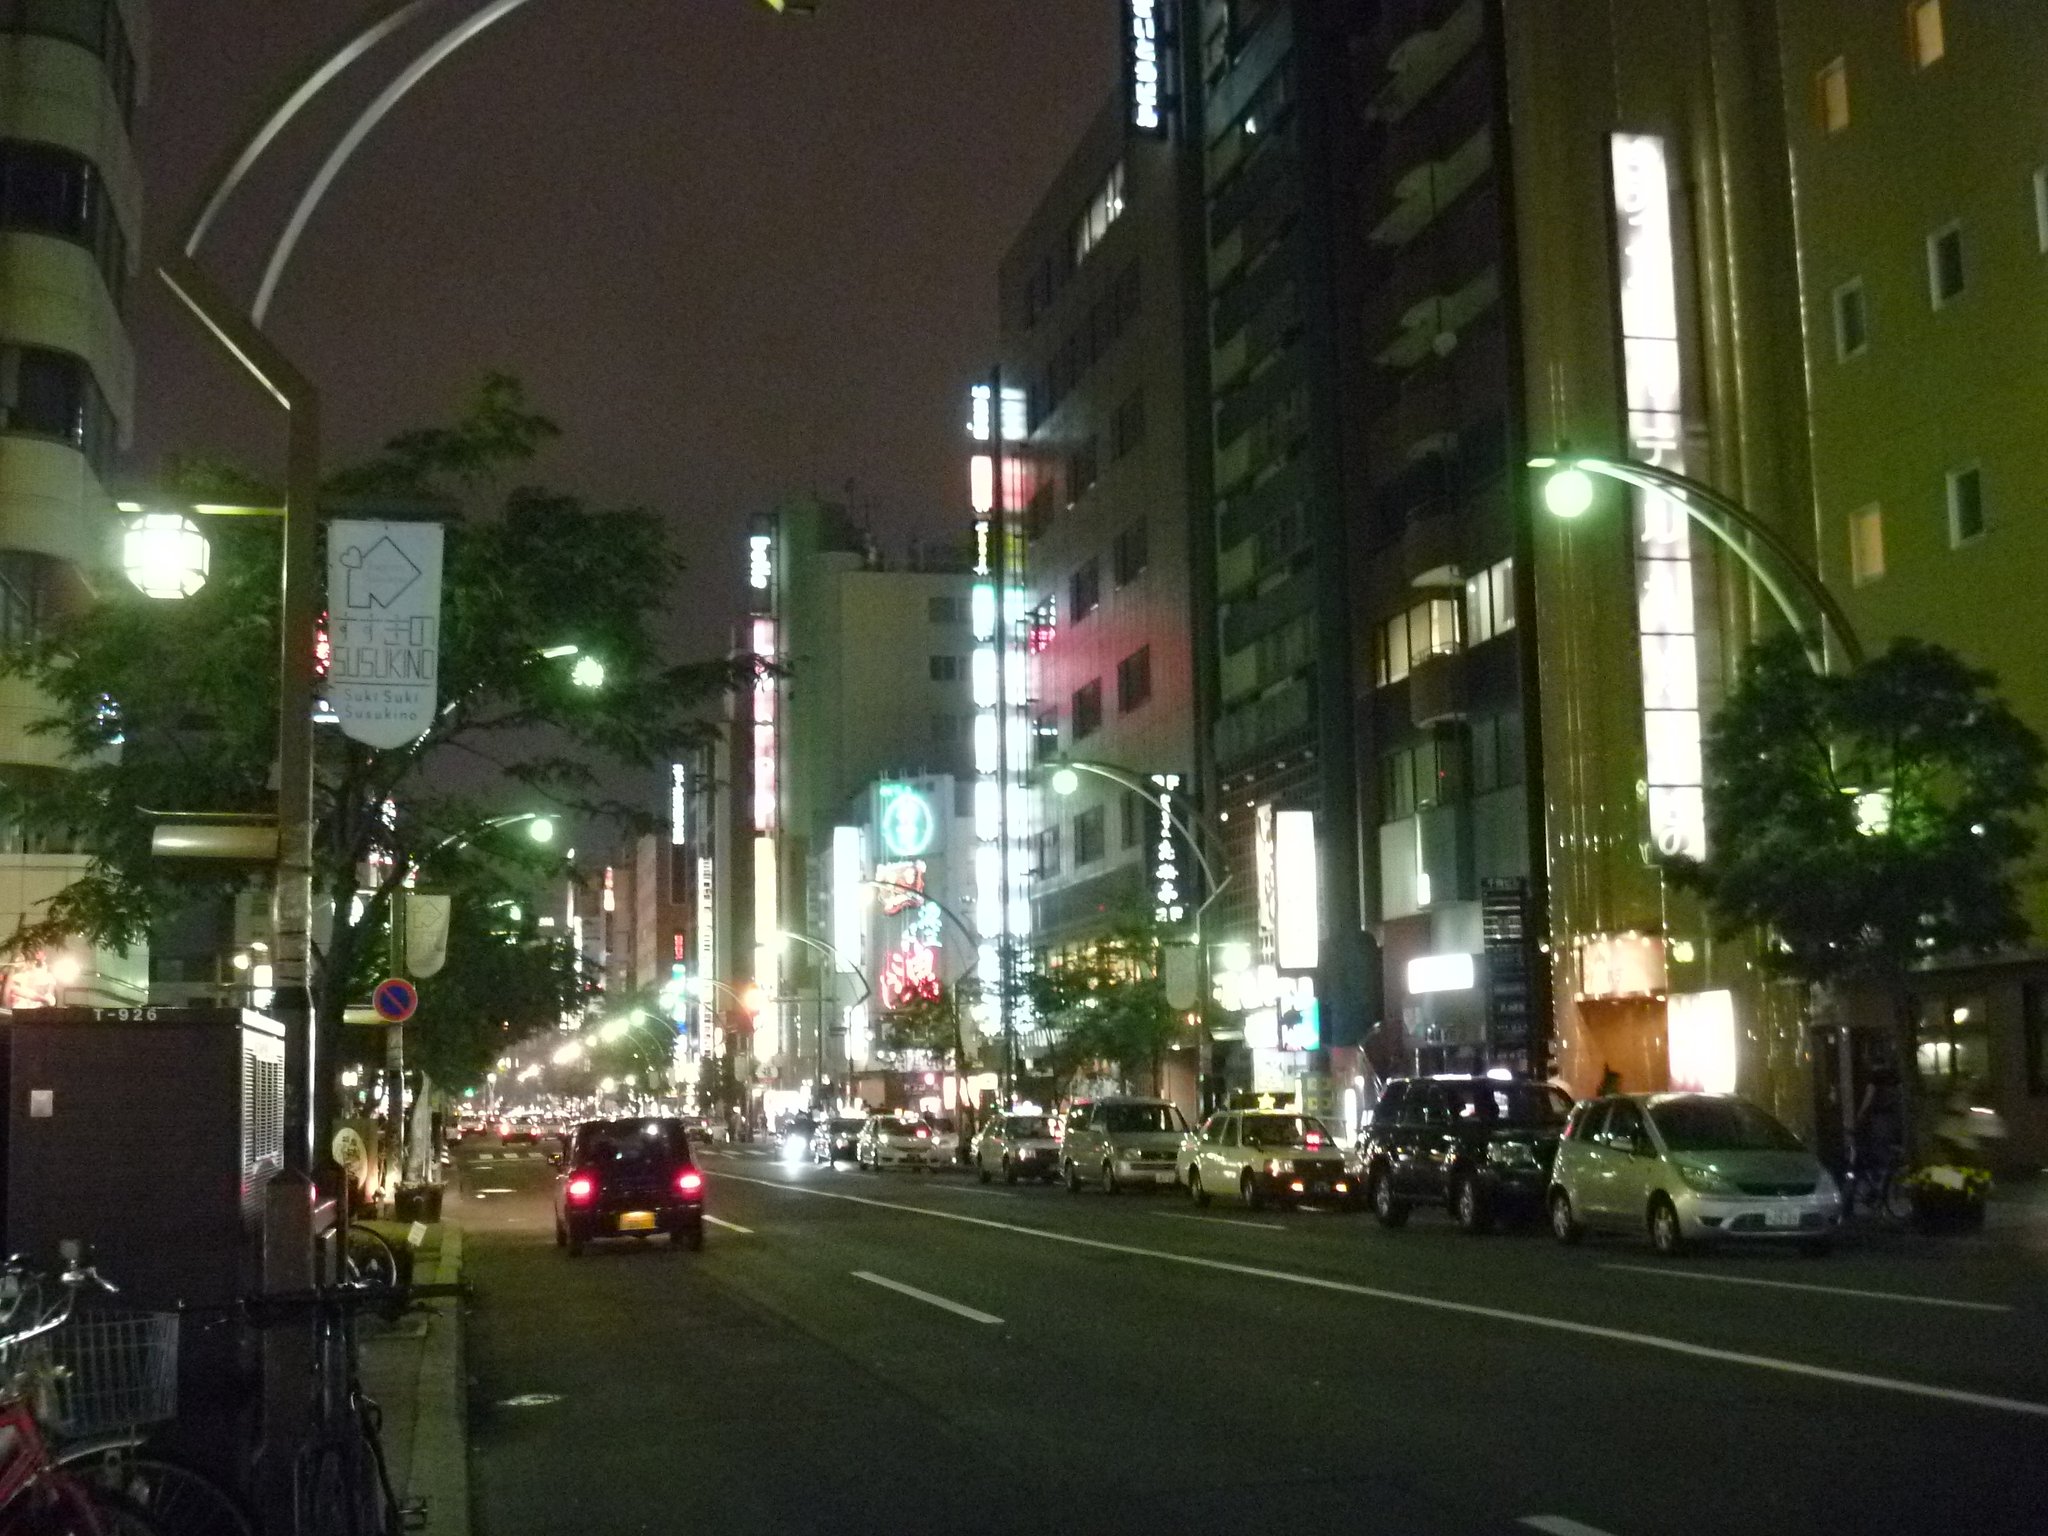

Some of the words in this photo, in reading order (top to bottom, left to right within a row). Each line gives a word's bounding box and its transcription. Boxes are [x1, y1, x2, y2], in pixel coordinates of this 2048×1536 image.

[333, 647, 434, 679] SUSUKINO
[345, 690, 377, 702] Suki
[383, 690, 418, 703] Suki
[345, 707, 418, 721] Susukino
[93, 1007, 157, 1022] T-926
